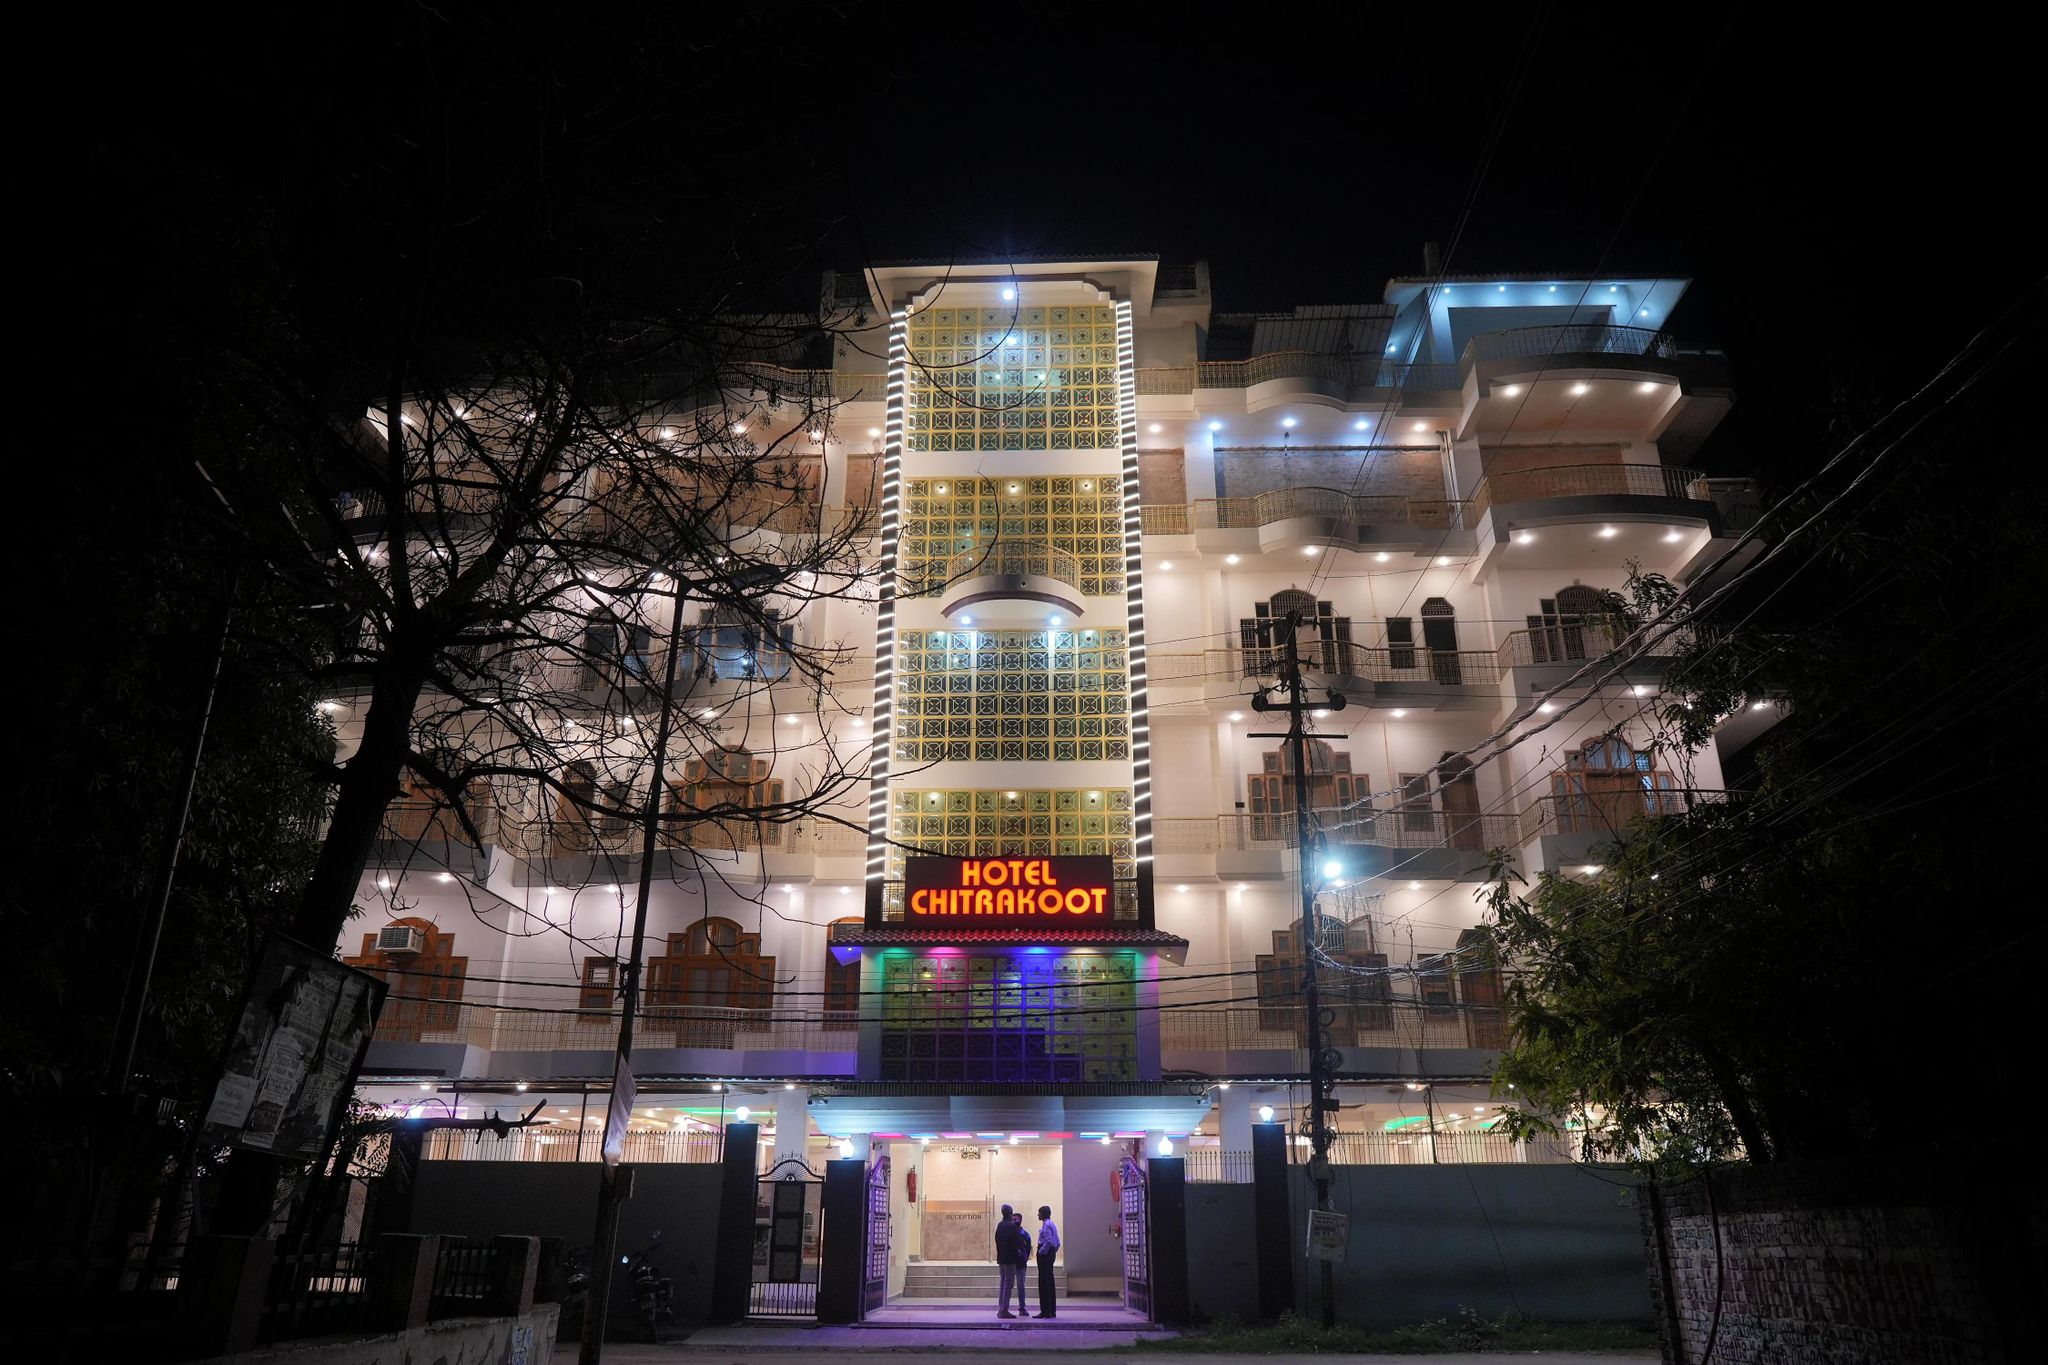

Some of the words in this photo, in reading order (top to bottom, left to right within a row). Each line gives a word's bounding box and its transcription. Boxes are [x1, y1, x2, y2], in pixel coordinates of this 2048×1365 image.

[962, 859, 1057, 887] HOTEL
[910, 887, 1108, 915] CHITRAKOOT
[940, 1145, 979, 1153] RECEPTION
